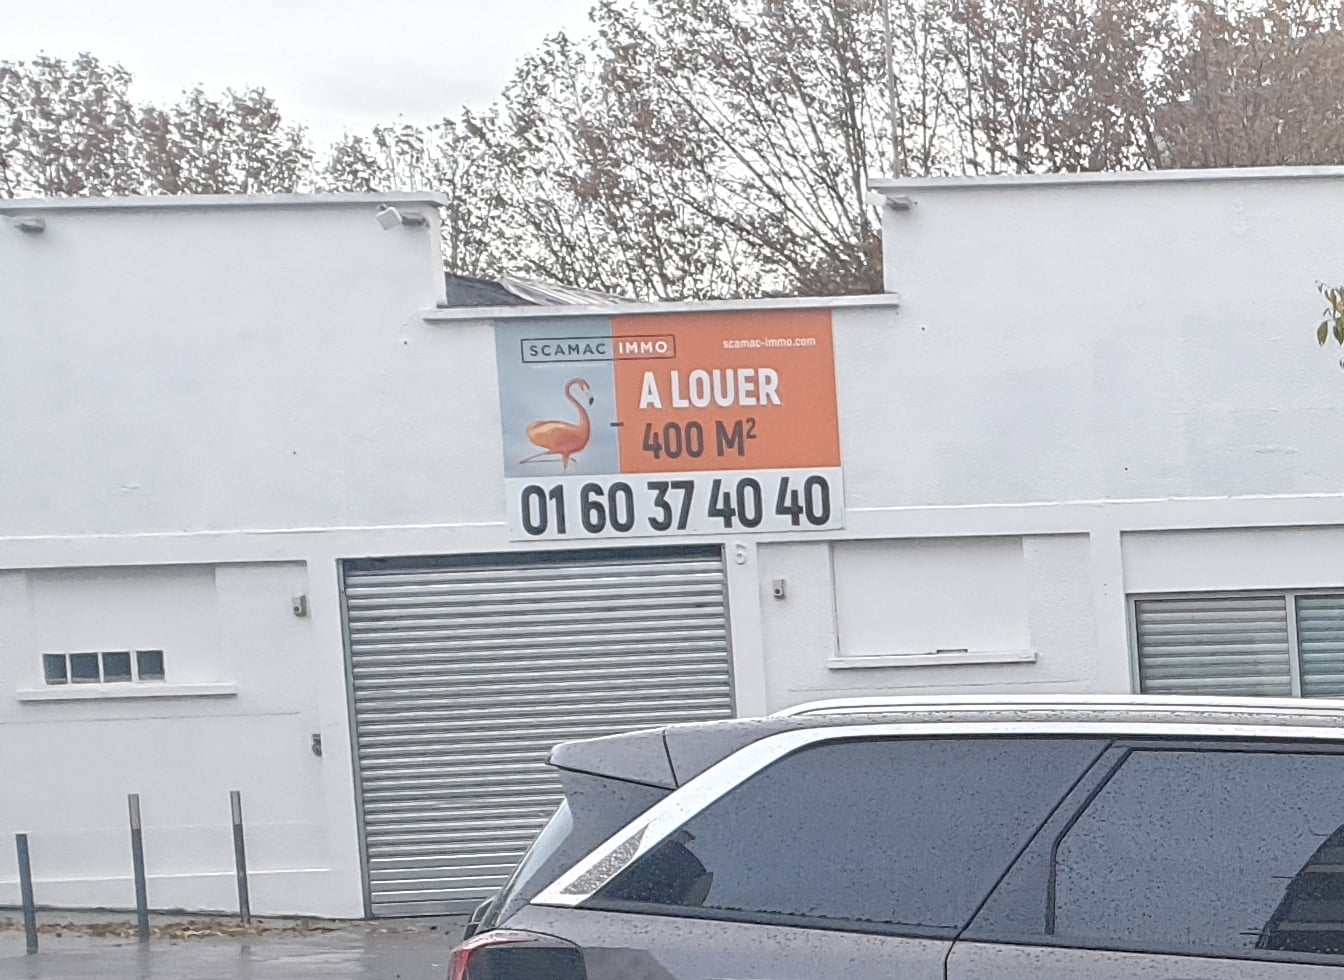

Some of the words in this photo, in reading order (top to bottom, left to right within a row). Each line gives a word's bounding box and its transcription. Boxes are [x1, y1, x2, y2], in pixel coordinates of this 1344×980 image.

[528, 342, 607, 357] SCAMAC
[618, 340, 668, 354] IMMO
[722, 337, 817, 350] scamac-immo.com
[639, 371, 662, 409] A
[670, 367, 782, 408] LOUER
[642, 421, 704, 459] 400
[520, 484, 567, 536] 01
[580, 481, 636, 534] 60
[646, 480, 695, 531] 37
[707, 477, 763, 529] 40
[775, 475, 832, 527] 40
